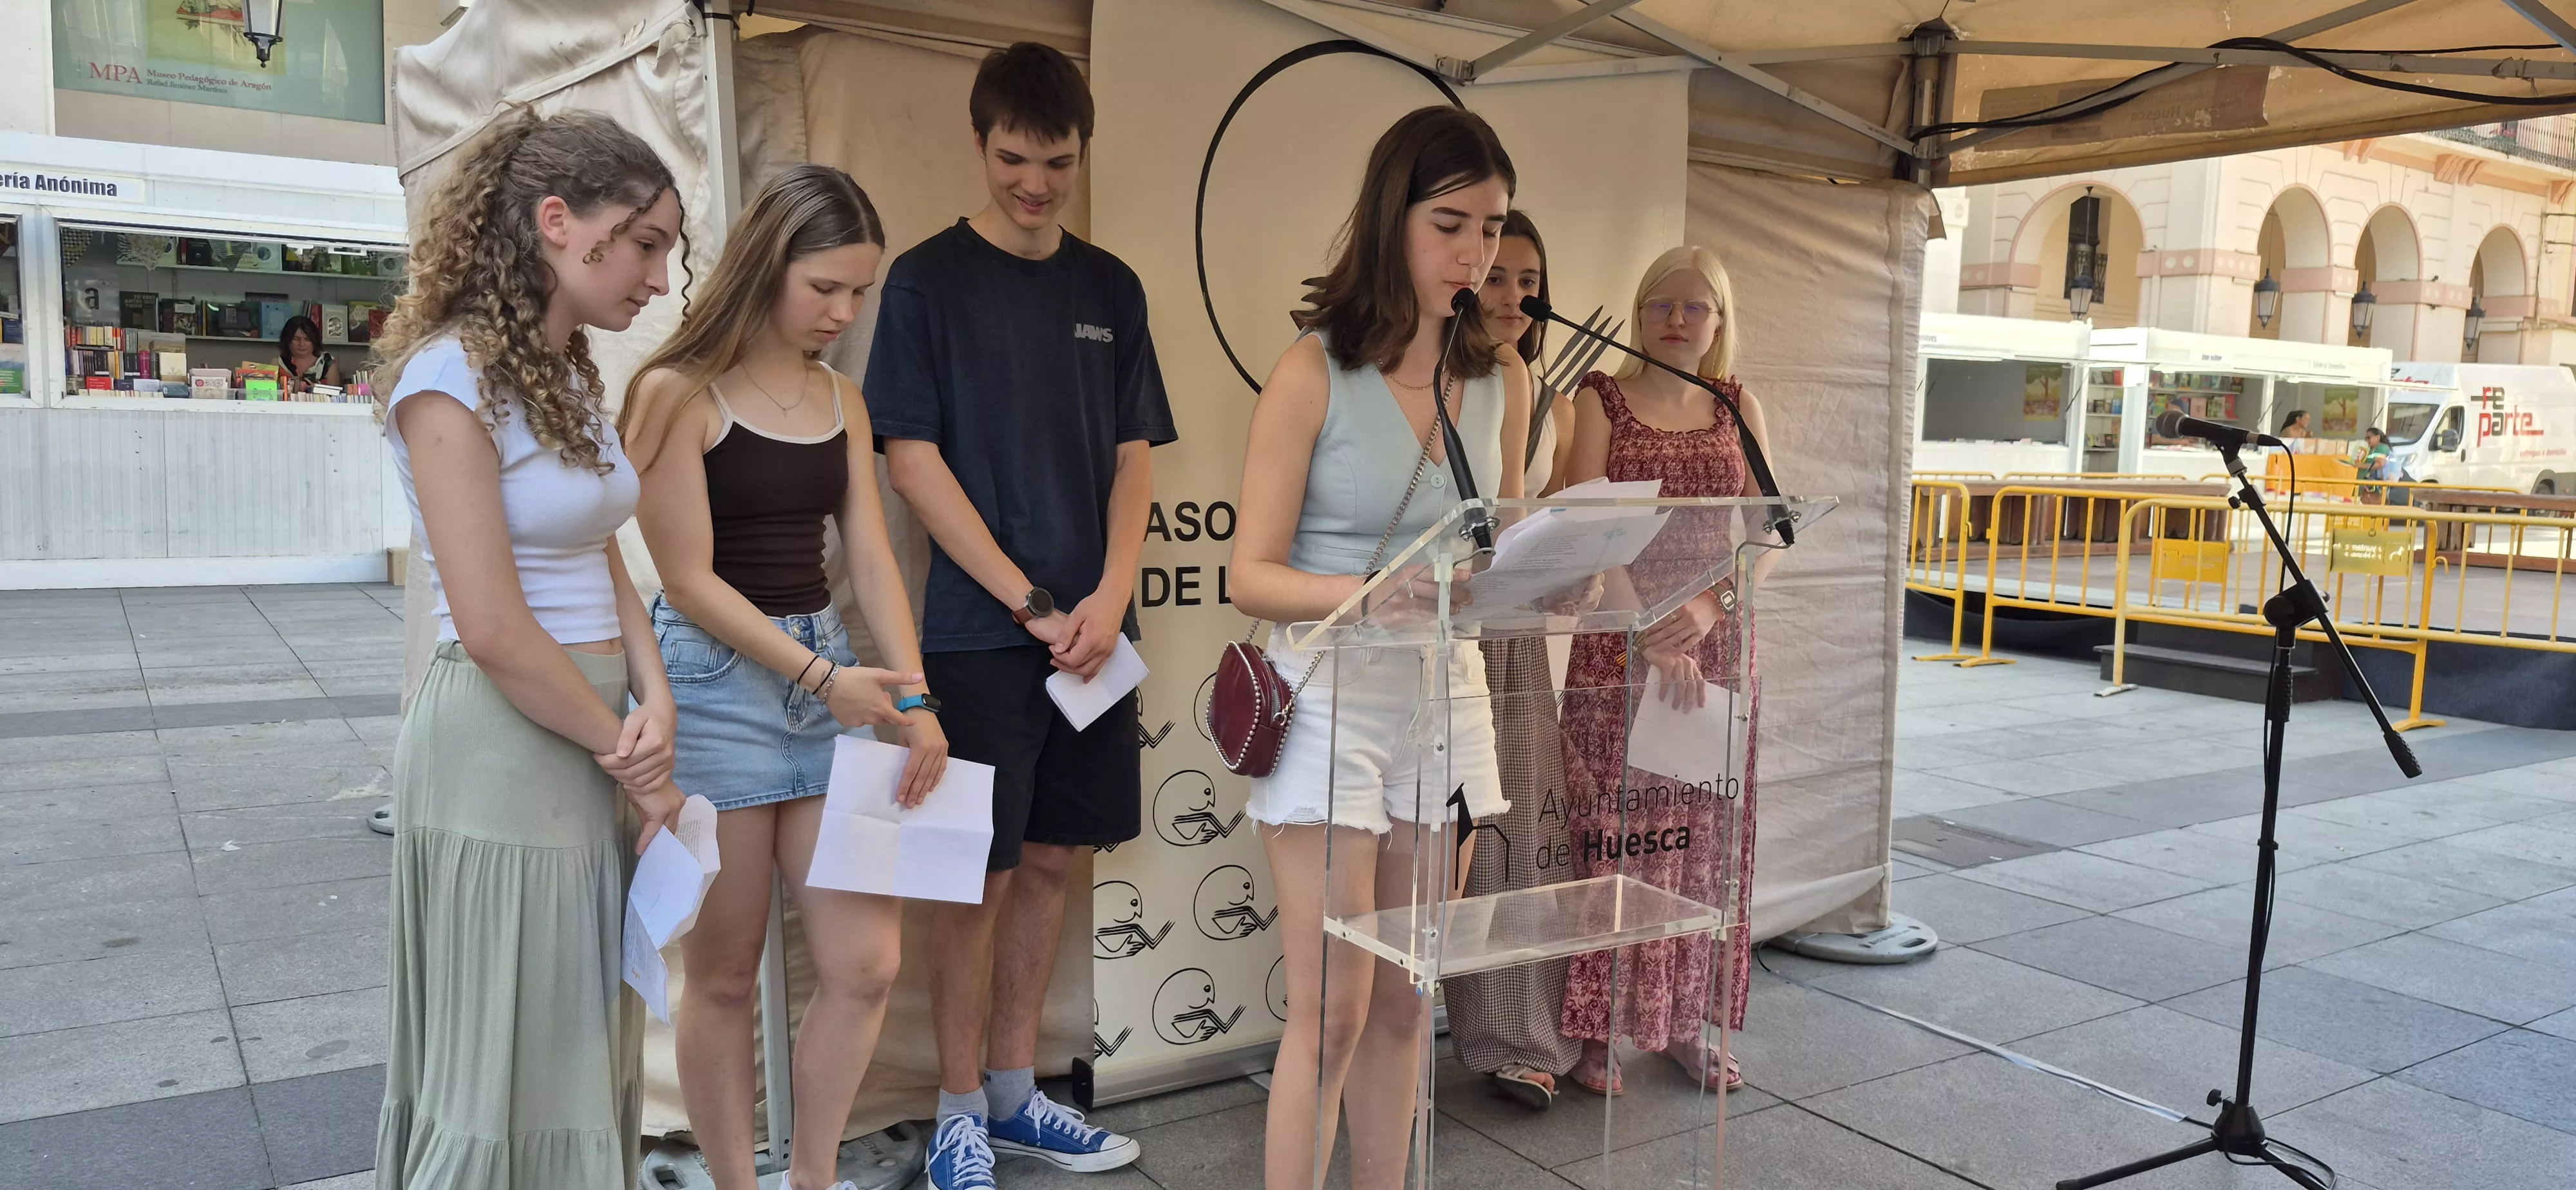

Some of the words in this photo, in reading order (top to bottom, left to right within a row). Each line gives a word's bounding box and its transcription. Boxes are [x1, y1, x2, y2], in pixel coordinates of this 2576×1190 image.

[89, 62, 142, 84] MPA
[147, 69, 176, 79] Museo
[178, 72, 227, 86] Pedagógico
[241, 80, 272, 91] Aragón
[147, 78, 169, 86] Rafael
[169, 81, 196, 90] Jiménez
[198, 84, 229, 94] Martínez
[35, 174, 118, 197] Anónima
[1074, 323, 1113, 343] JAWS
[2471, 387, 2505, 410] re
[2477, 405, 2544, 448] parte
[1143, 501, 1236, 542] ASO
[1142, 567, 1201, 607] DE
[1538, 772, 1739, 829] Ayuntamiento
[1537, 838, 1569, 869] de
[1583, 826, 1690, 863] Huesca
